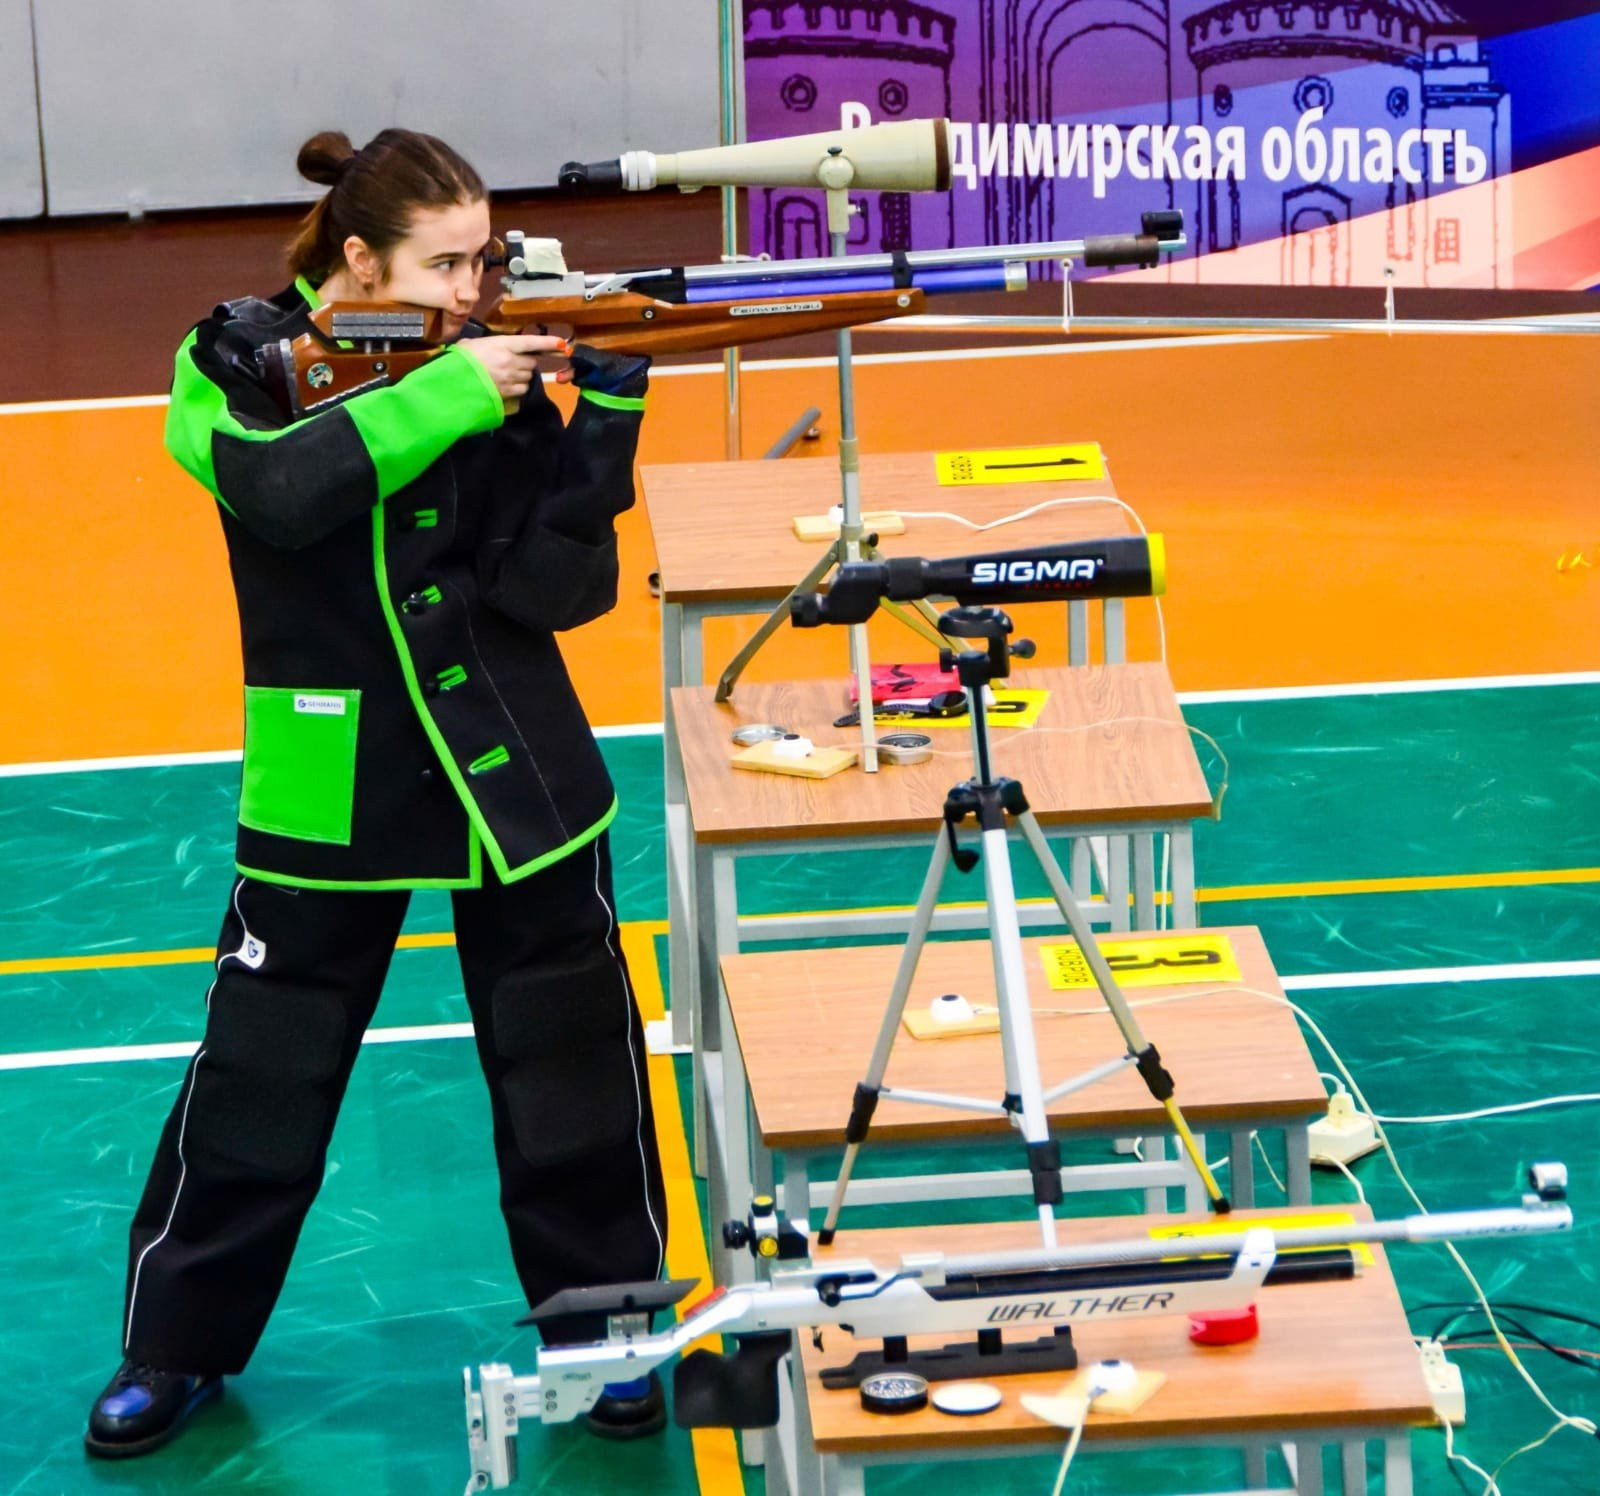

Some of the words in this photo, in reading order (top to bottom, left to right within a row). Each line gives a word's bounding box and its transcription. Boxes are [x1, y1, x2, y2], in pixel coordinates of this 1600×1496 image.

[840, 100, 1246, 198] димирская
[1261, 105, 1487, 184] область
[984, 458, 1088, 470] 1
[971, 559, 1096, 583] SIGMA
[1104, 950, 1221, 972] 3
[986, 1292, 1175, 1323] WALTHER
